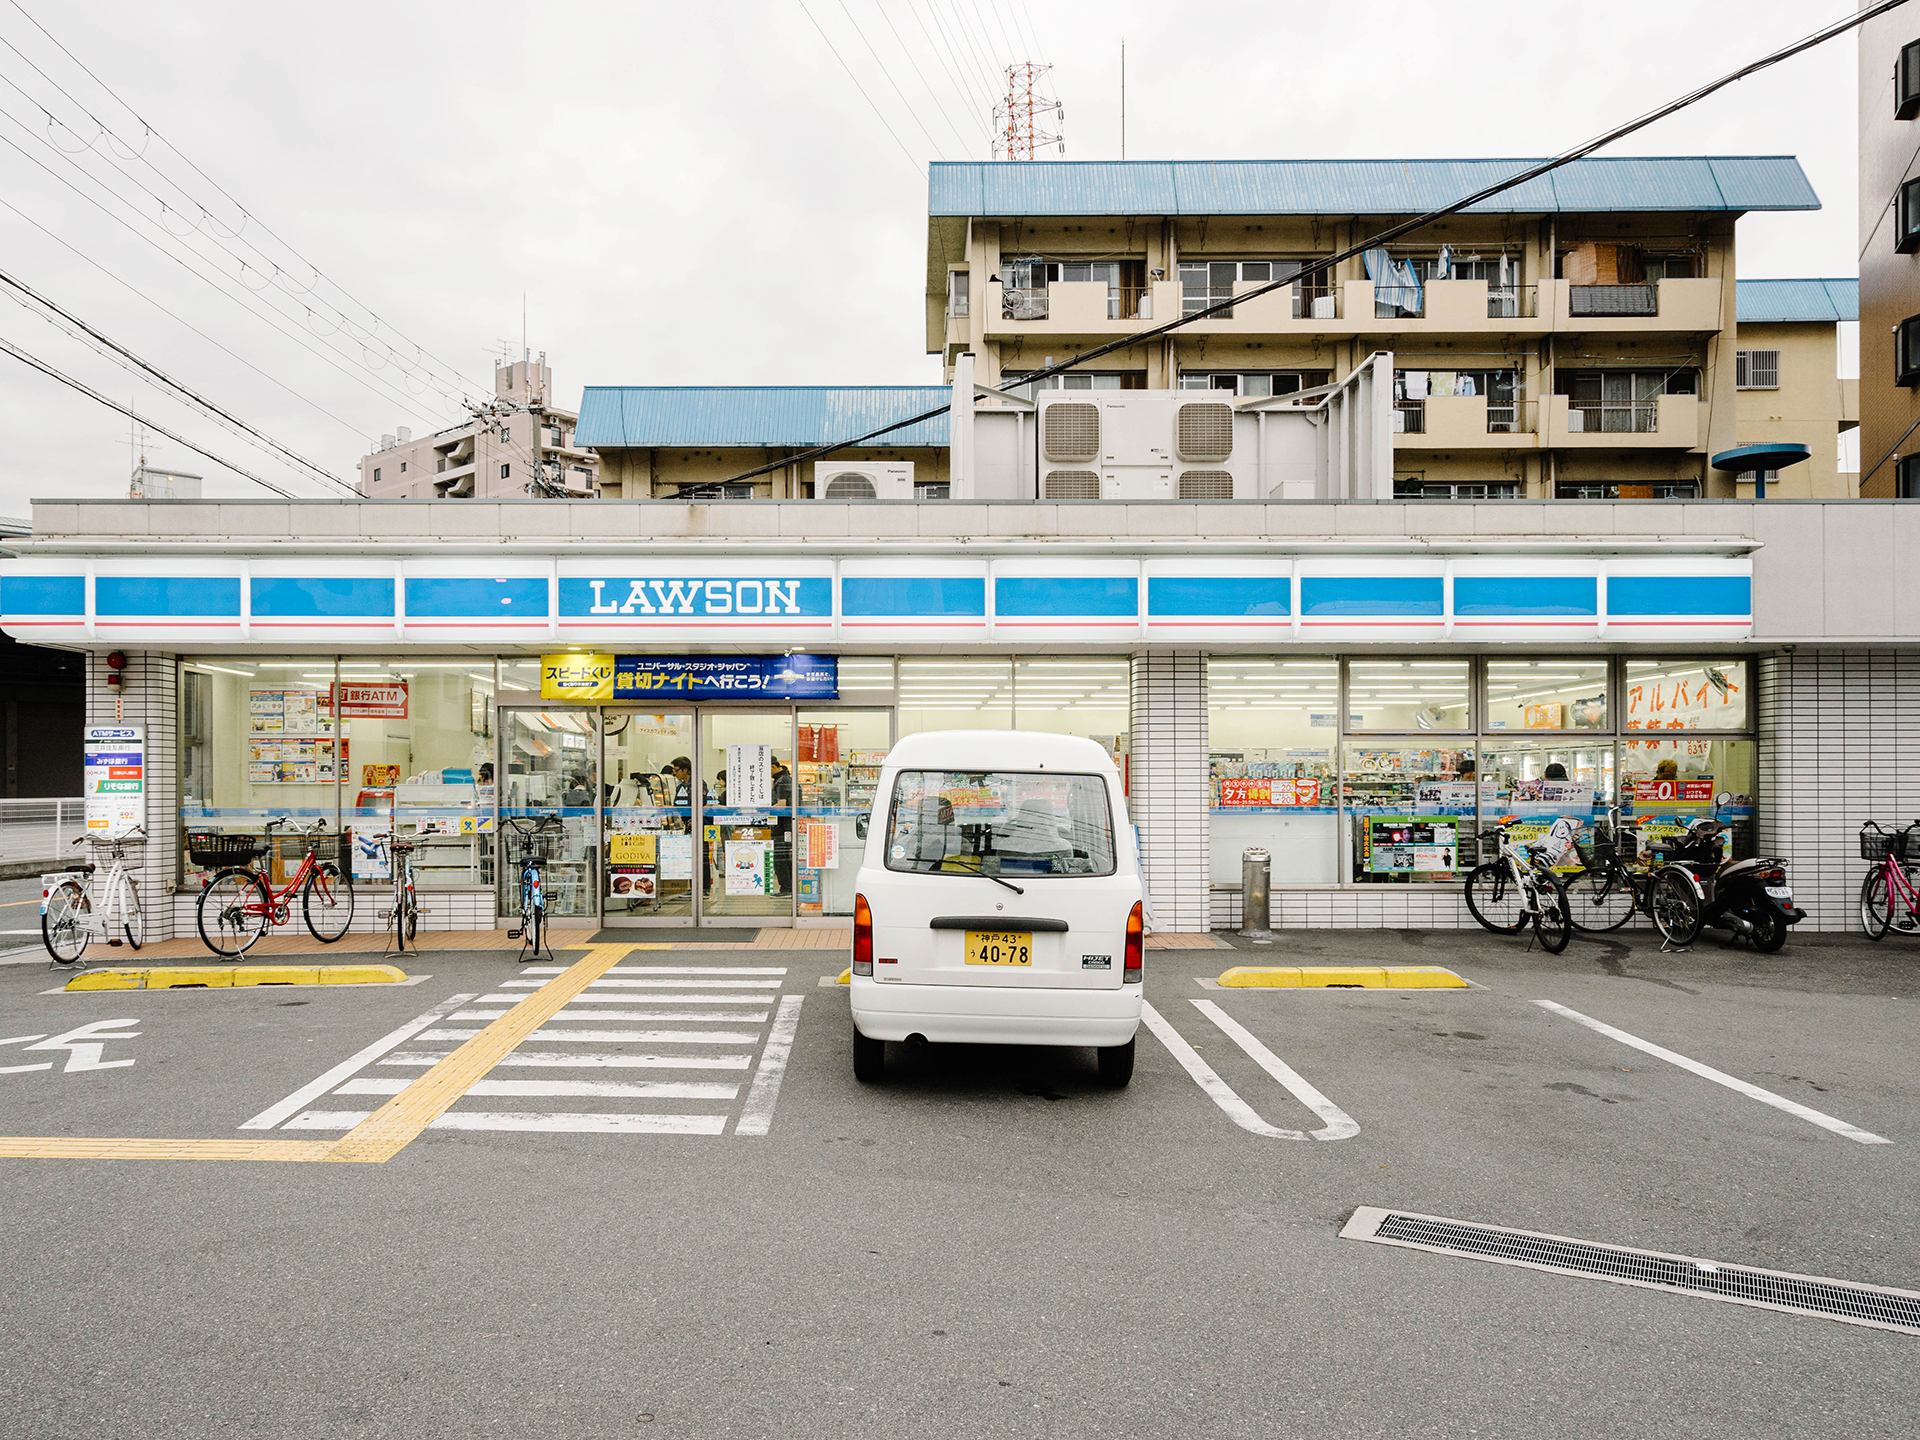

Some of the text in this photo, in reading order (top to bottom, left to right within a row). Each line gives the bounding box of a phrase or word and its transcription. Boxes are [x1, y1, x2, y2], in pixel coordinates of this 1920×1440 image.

[590, 581, 800, 613] LAWSON
[546, 667, 611, 679] スピードくじ
[616, 672, 770, 689] 貸切ナイトへ行こう!
[350, 690, 397, 701] 銀行ATM
[1629, 674, 1739, 714] アルバイト
[104, 782, 139, 790] りそな銀行
[1224, 788, 1270, 800] 夕方得割
[741, 828, 754, 837] 24
[1509, 825, 1548, 833] スタンプためて
[1646, 825, 1684, 833] スタンプためて
[615, 852, 651, 860] GODIVA
[981, 934, 1016, 943] 神戸 43
[971, 945, 1028, 963] う 40-78
